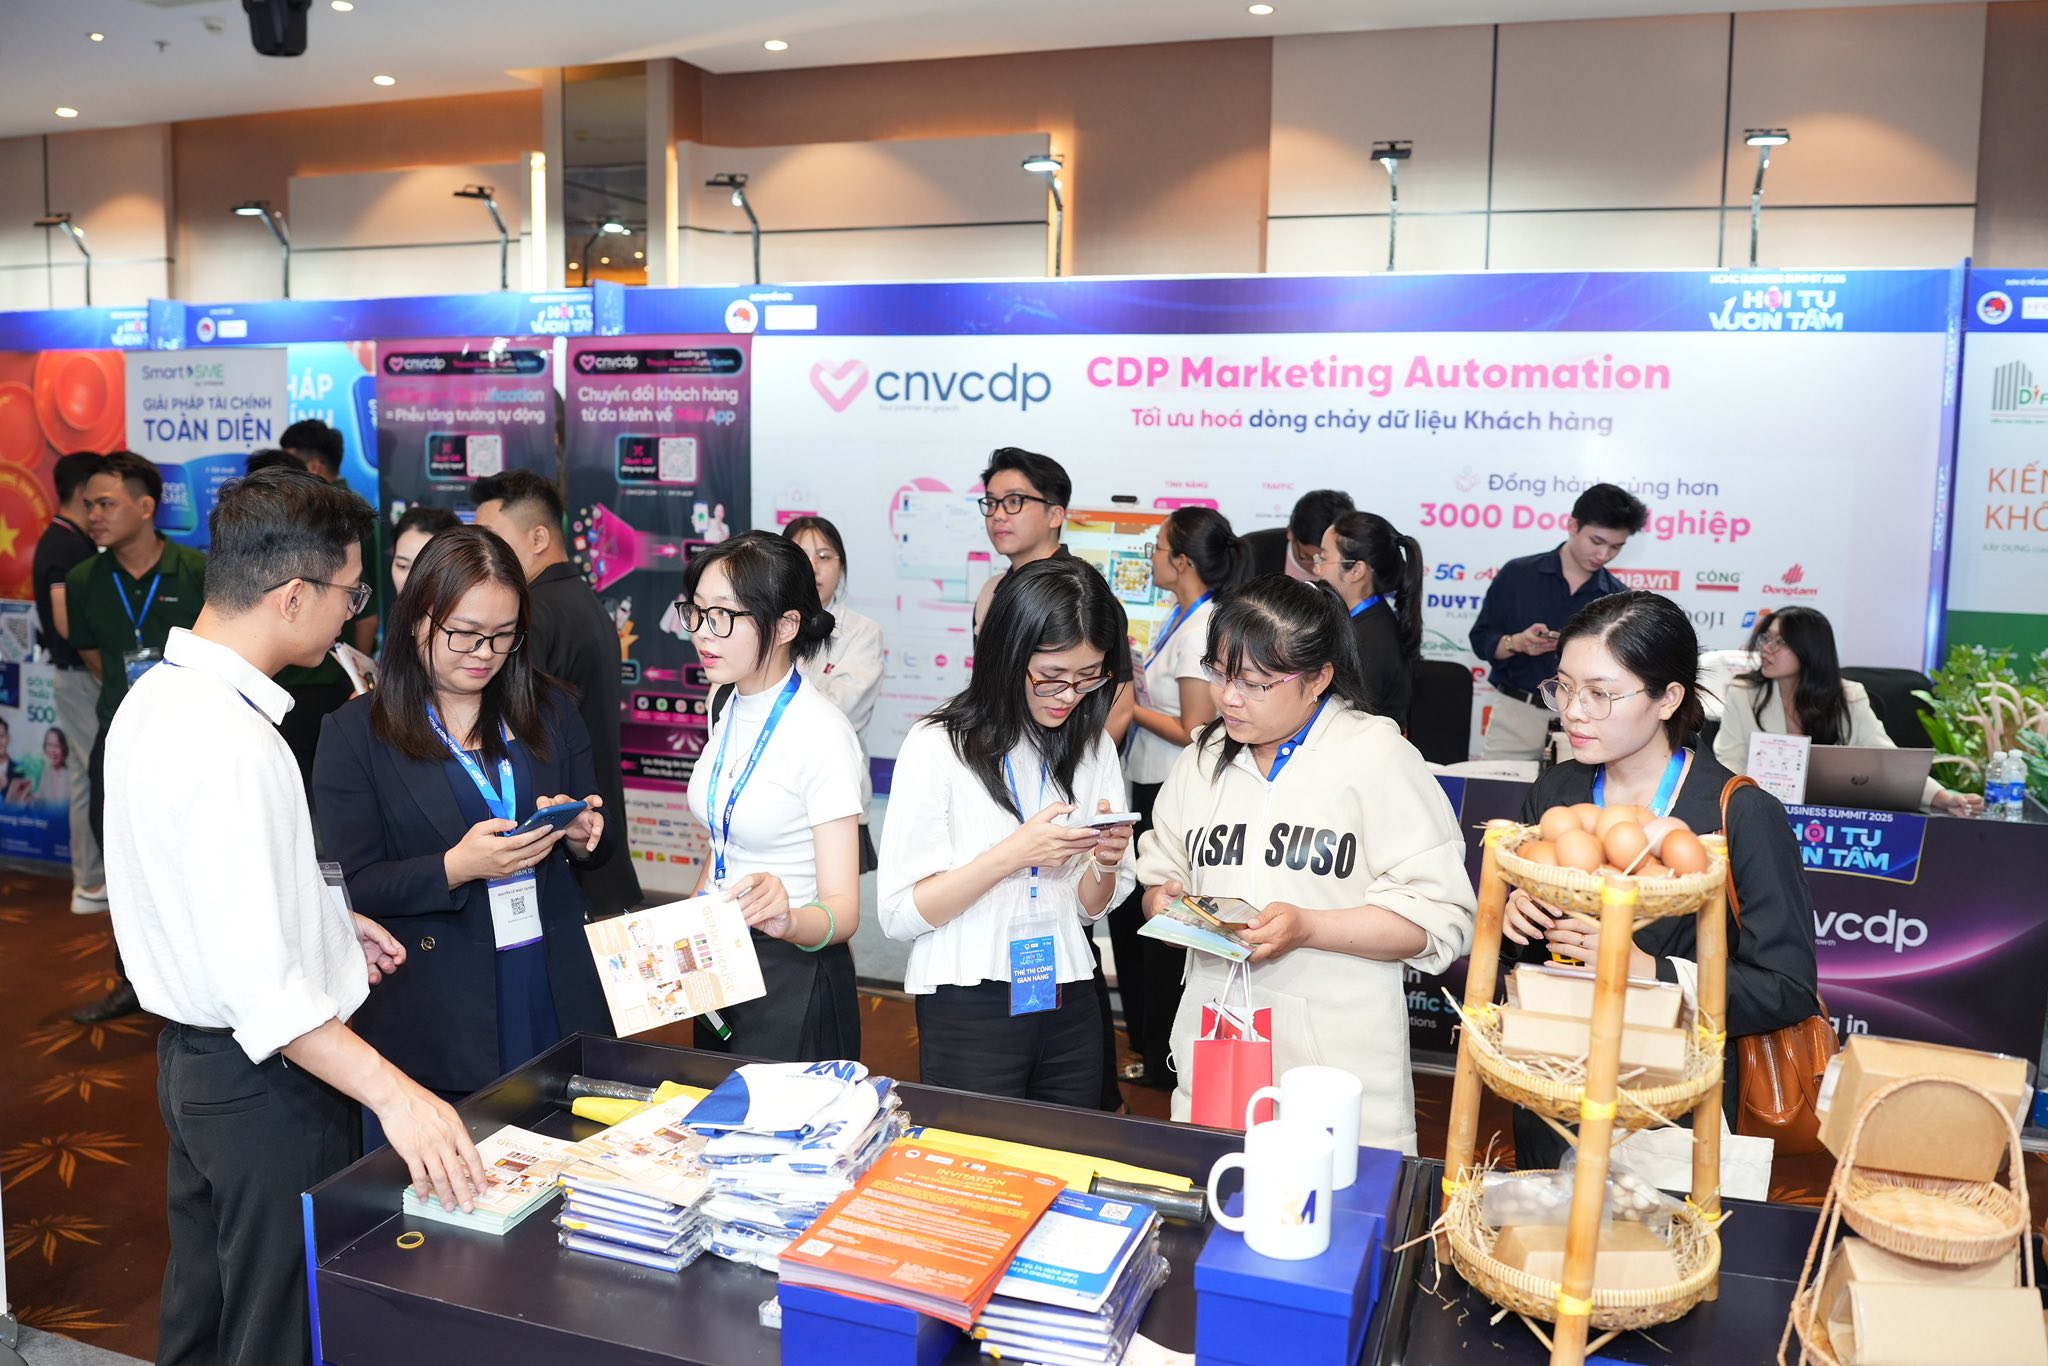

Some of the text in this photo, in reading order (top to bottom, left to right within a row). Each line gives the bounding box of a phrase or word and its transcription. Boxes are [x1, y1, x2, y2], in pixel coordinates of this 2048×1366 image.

[142, 364, 185, 381] Smart
[1087, 353, 1670, 397] CDP Marketing Automation
[875, 362, 1051, 411] cnvcdp
[705, 408, 736, 426] App
[1249, 408, 1307, 434] dòng
[1415, 410, 1457, 435] liệu
[1463, 410, 1542, 431] Khách
[1548, 411, 1614, 436] hàng
[143, 412, 272, 448] TOÀN DIỆN
[1488, 472, 1546, 497] Đồng
[1677, 478, 1719, 497] hơn
[1419, 503, 1503, 529] 3000
[1435, 563, 1466, 581] 5G
[1428, 594, 1482, 610] DUYT
[27, 704, 55, 723] 500
[1828, 809, 1868, 821] SUMMIT
[1868, 812, 1894, 823] 2025
[1840, 827, 1882, 850] TỤ
[1264, 822, 1357, 880] SUSO
[1828, 846, 1890, 871] TẦM
[1408, 991, 1441, 1013] ffic
[1409, 1015, 1438, 1029] tions
[936, 1168, 1006, 1187] INVITATION
